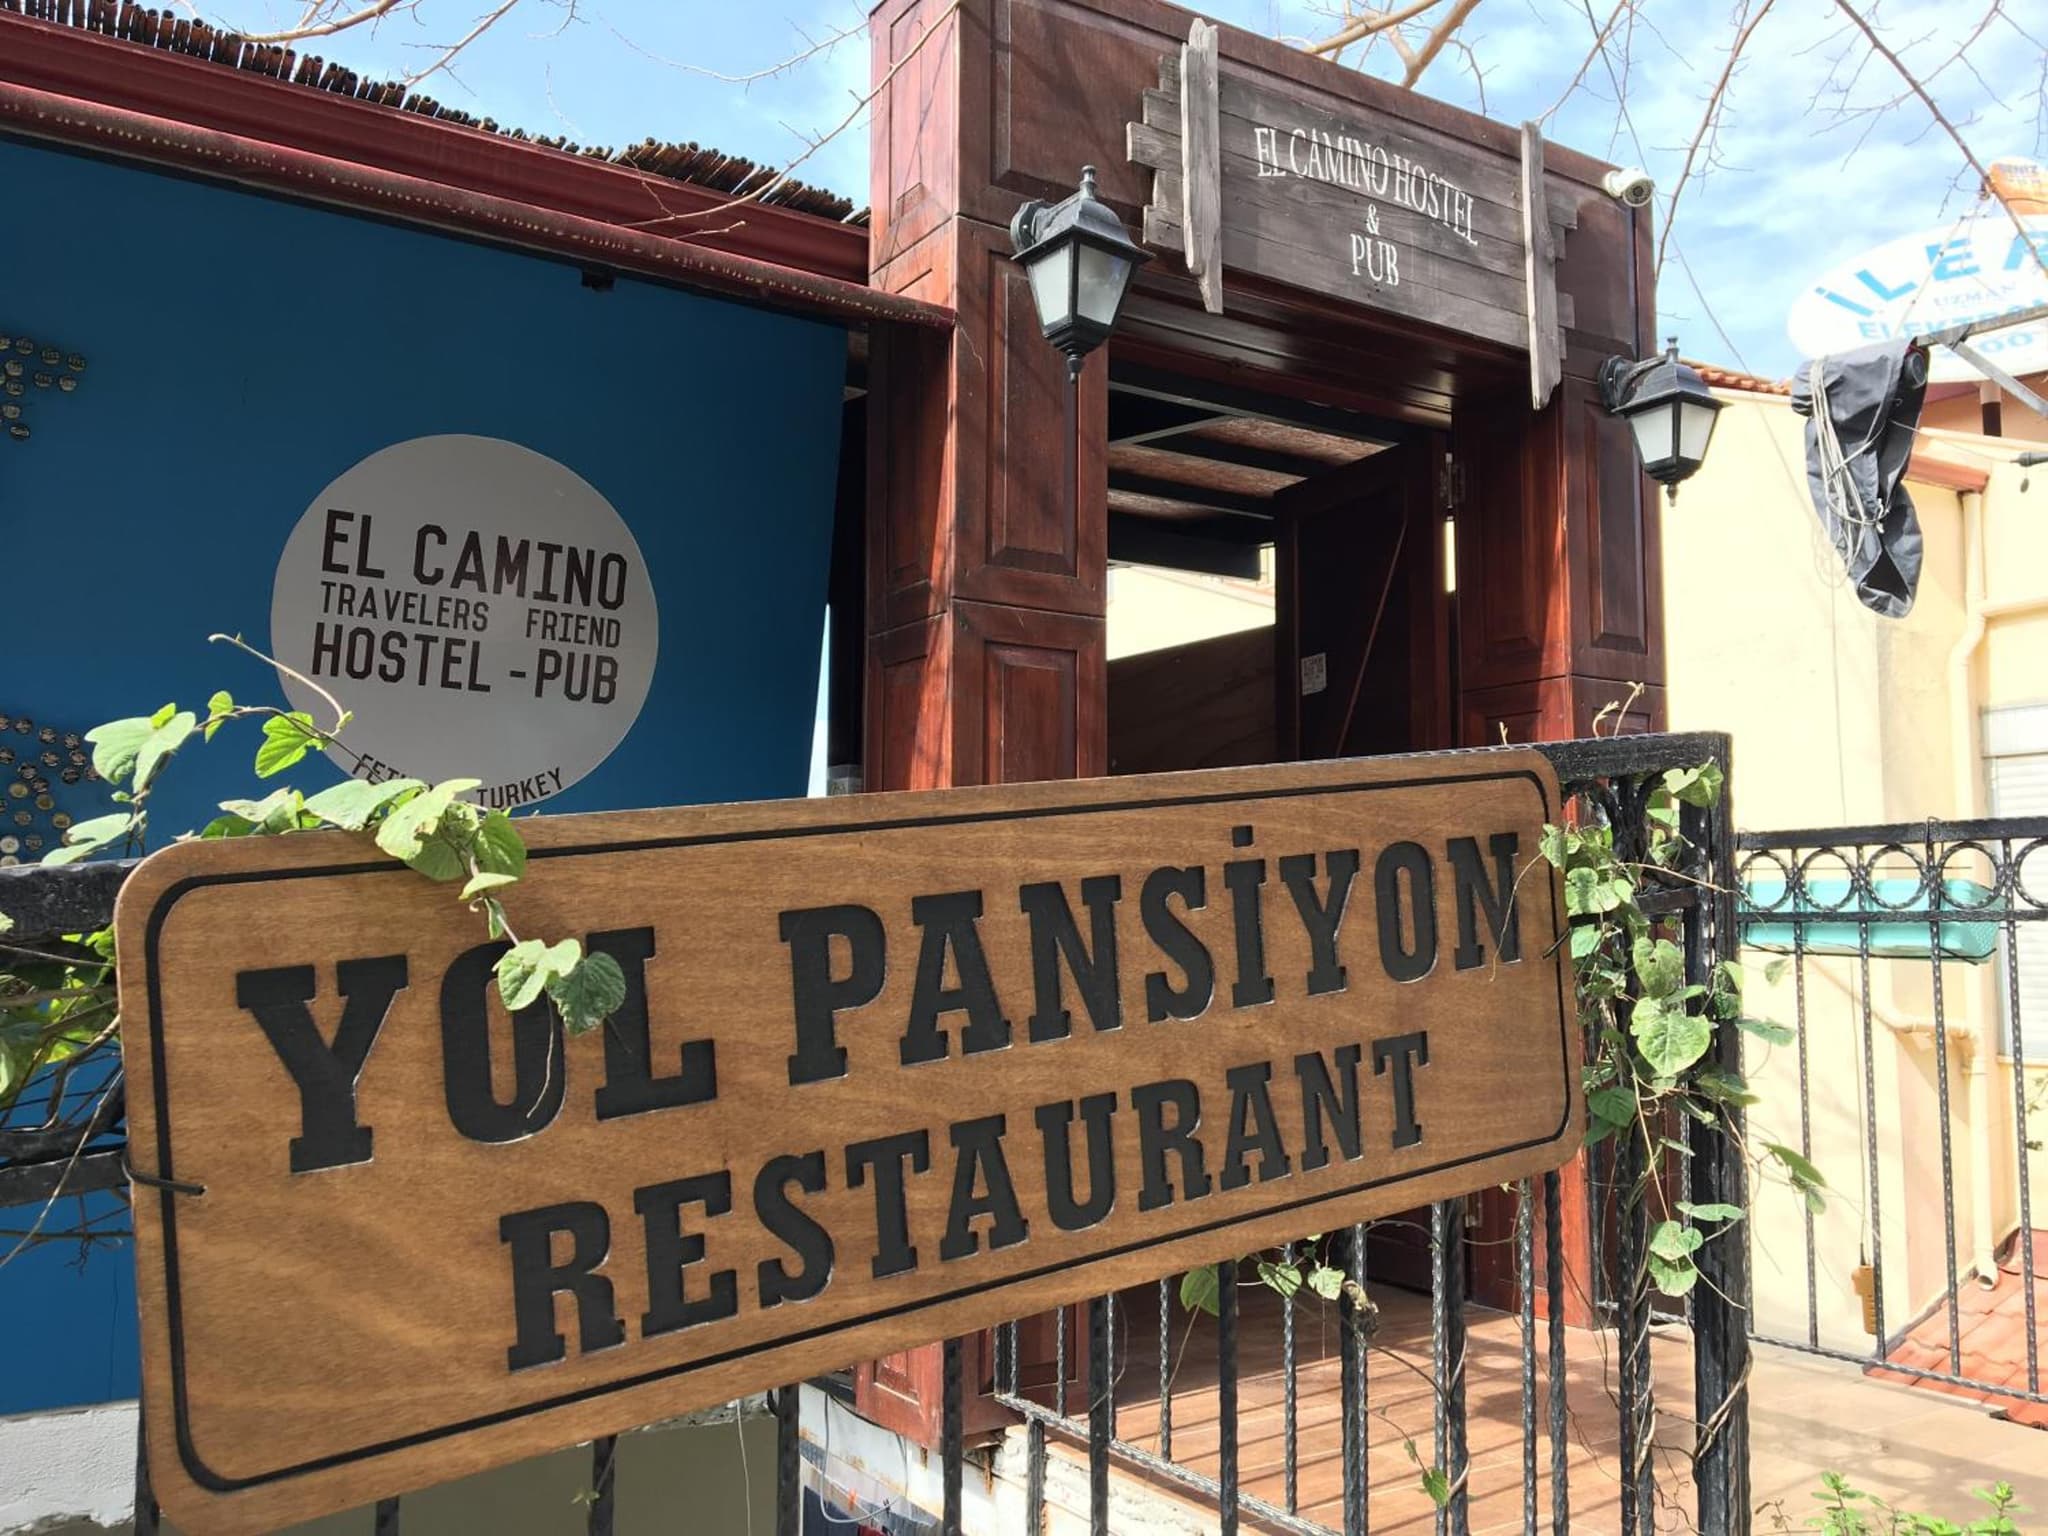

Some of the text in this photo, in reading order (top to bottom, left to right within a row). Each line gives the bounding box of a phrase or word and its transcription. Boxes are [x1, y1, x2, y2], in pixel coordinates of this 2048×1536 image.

[1254, 127, 1478, 246] EL CAMINO HOSTEL
[1365, 203, 1380, 236] &
[1350, 233, 1399, 286] PUB
[321, 509, 628, 611] EL CAMINO
[321, 580, 622, 649] TRAVELERS FRIEND
[311, 621, 492, 693] HOSTEL
[476, 767, 565, 812] TURKEY
[235, 824, 1523, 1175] YOL PANSİYON
[499, 1029, 1430, 1372] RESTAURANT
